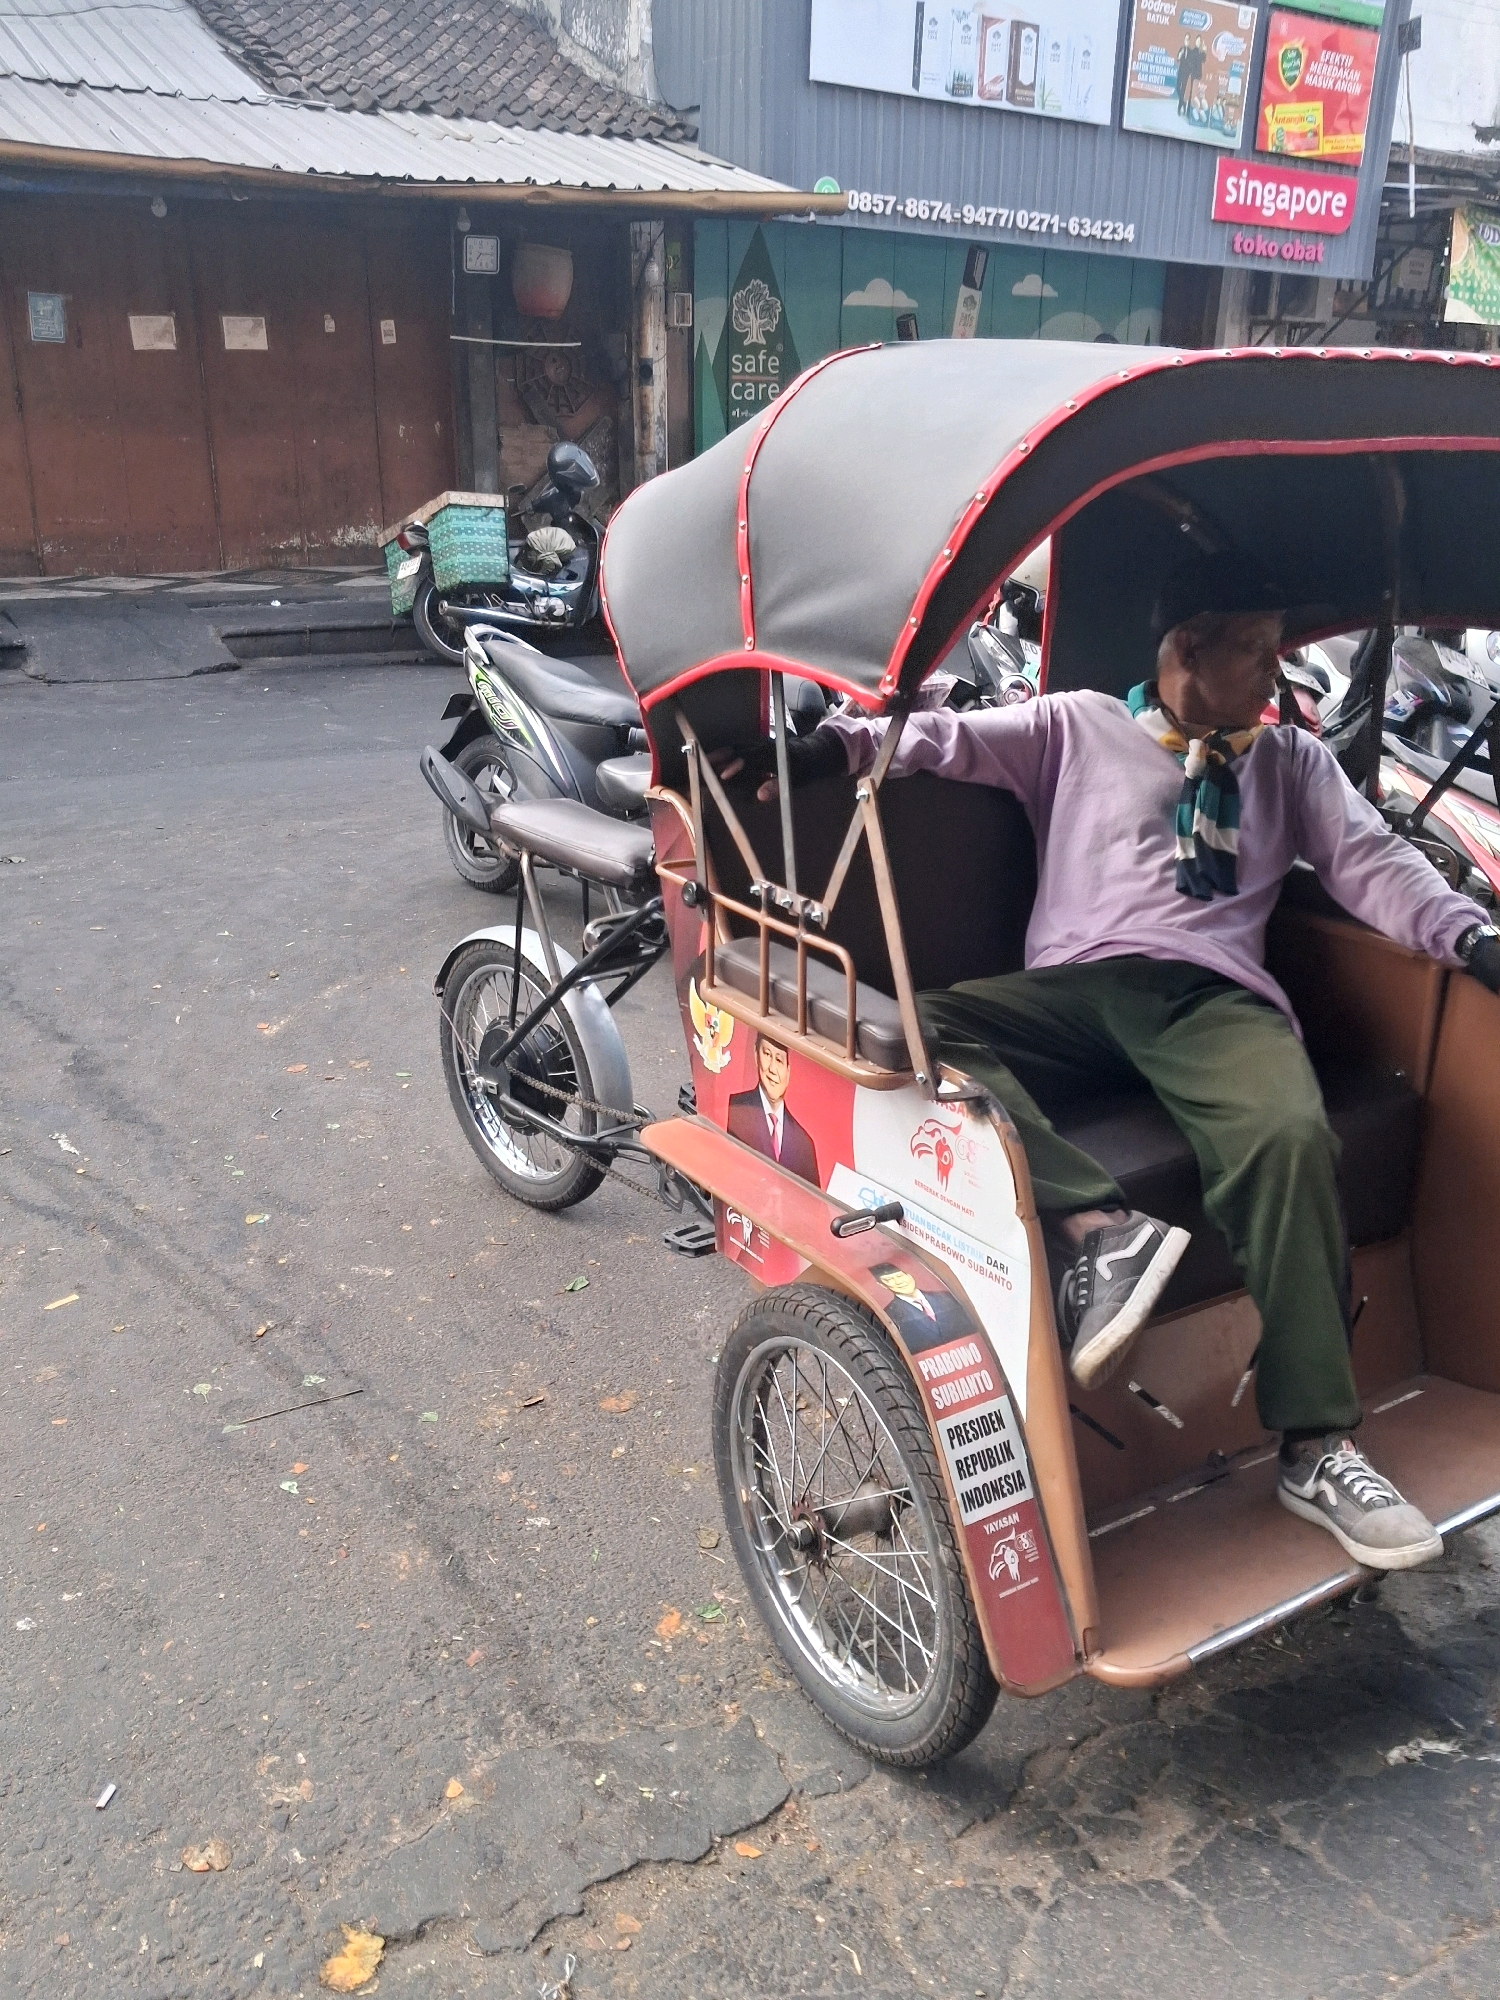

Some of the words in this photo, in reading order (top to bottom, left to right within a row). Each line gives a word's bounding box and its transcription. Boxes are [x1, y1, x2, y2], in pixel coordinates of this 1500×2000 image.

[1309, 61, 1361, 82] MEREDAKAN
[1320, 50, 1354, 67] EFEKTIF
[1304, 74, 1335, 90] MASUK
[1334, 81, 1362, 96] ANGIN
[1225, 168, 1348, 221] singapore
[1232, 231, 1279, 258] toko
[1280, 238, 1325, 263] obat
[731, 350, 780, 374] safe
[731, 382, 780, 401] care
[914, 1178, 940, 1199] BERGERAK
[939, 1194, 961, 1211] DENGAN
[961, 1205, 975, 1218] HATI
[925, 1232, 966, 1264] PRABOWO
[967, 1258, 1013, 1291] SUBIANTO
[926, 1221, 952, 1244] BECAK
[986, 1255, 1009, 1276] DARI
[918, 1342, 982, 1381] PRABOWO
[931, 1369, 994, 1410] SUBIANTO
[946, 1408, 1006, 1450] PRESIDEN
[955, 1439, 1016, 1481] REPUBLIK
[960, 1469, 1027, 1514] INDONESIA
[983, 1511, 1020, 1535] YAYASAN
